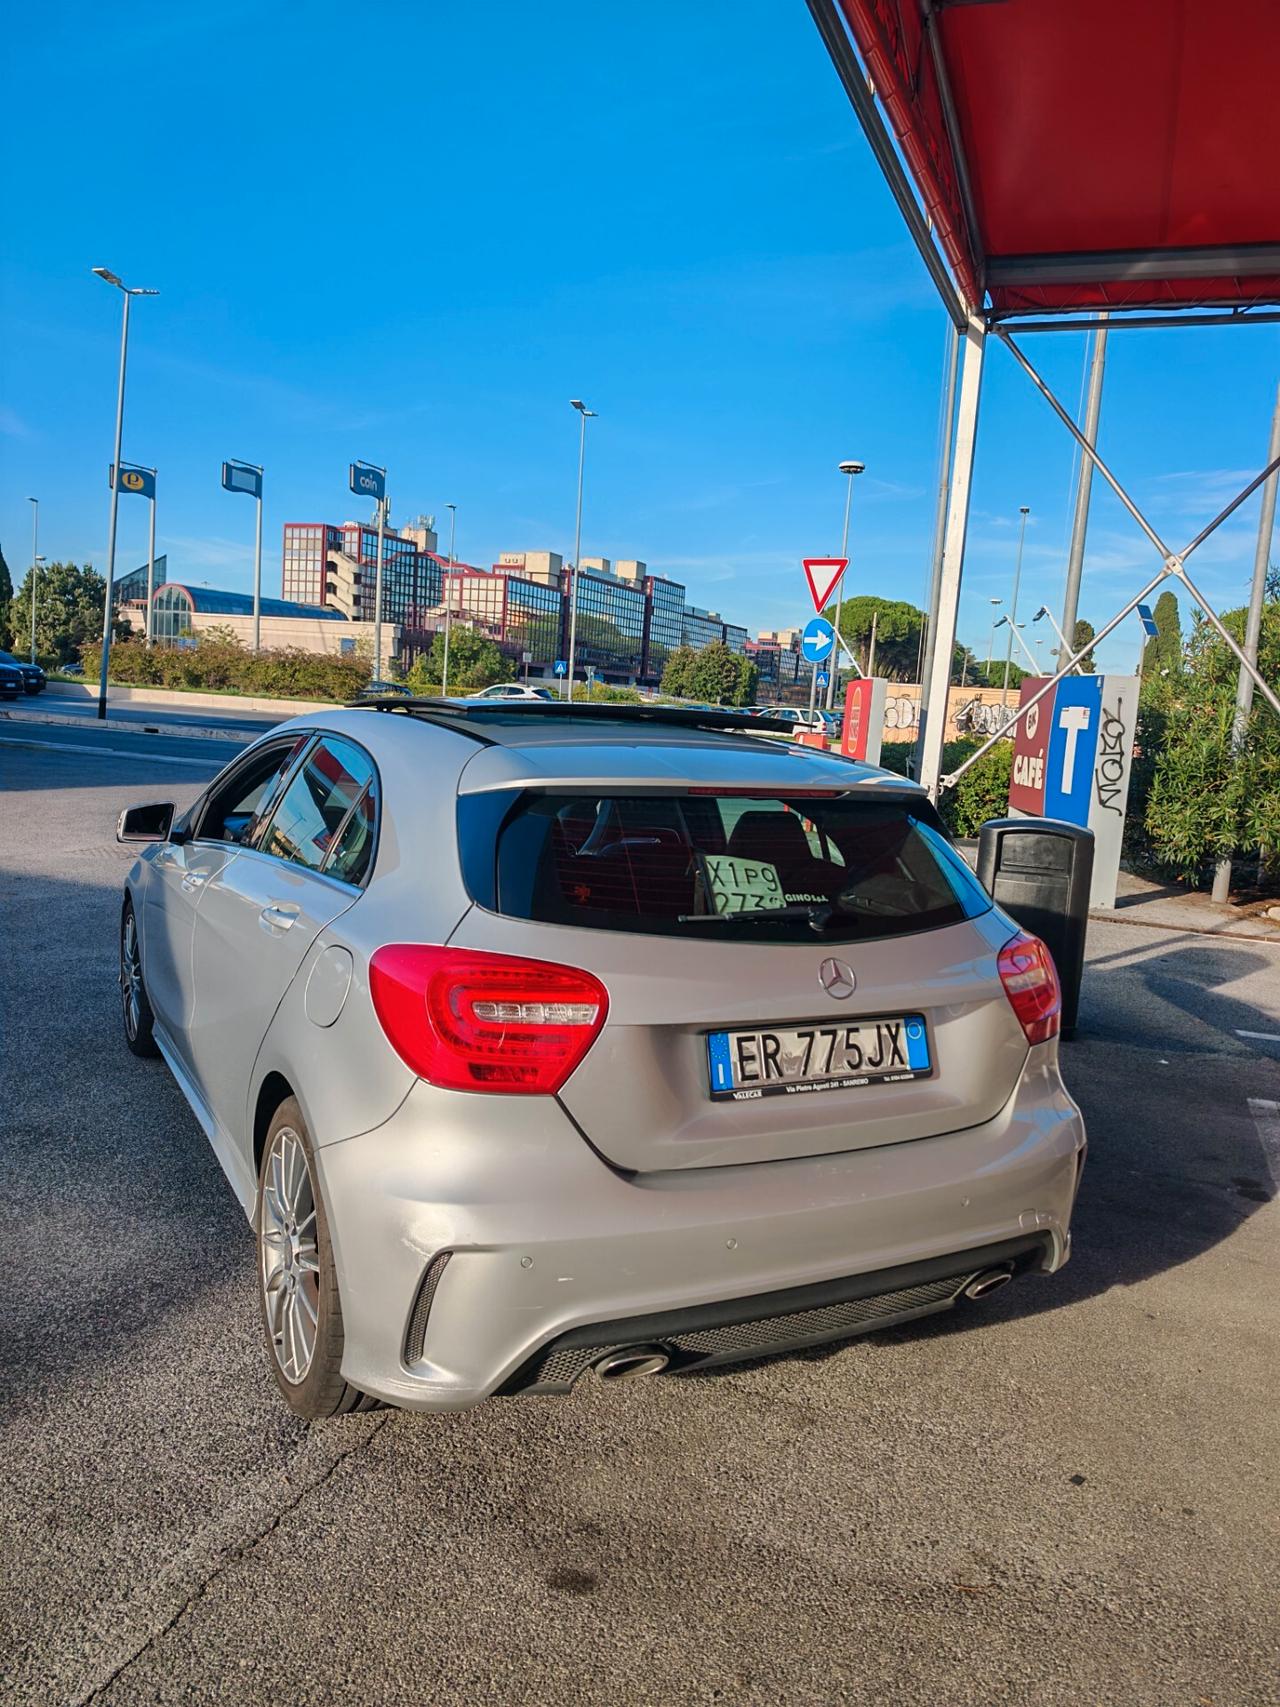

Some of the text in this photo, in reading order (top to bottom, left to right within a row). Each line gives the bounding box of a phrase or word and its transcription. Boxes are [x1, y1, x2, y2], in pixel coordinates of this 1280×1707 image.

[360, 474, 378, 491] coin
[1013, 748, 1044, 790] CAFÉ
[785, 893, 809, 903] GINO
[736, 1033, 783, 1082] ER
[733, 1089, 763, 1100] VALECAR
